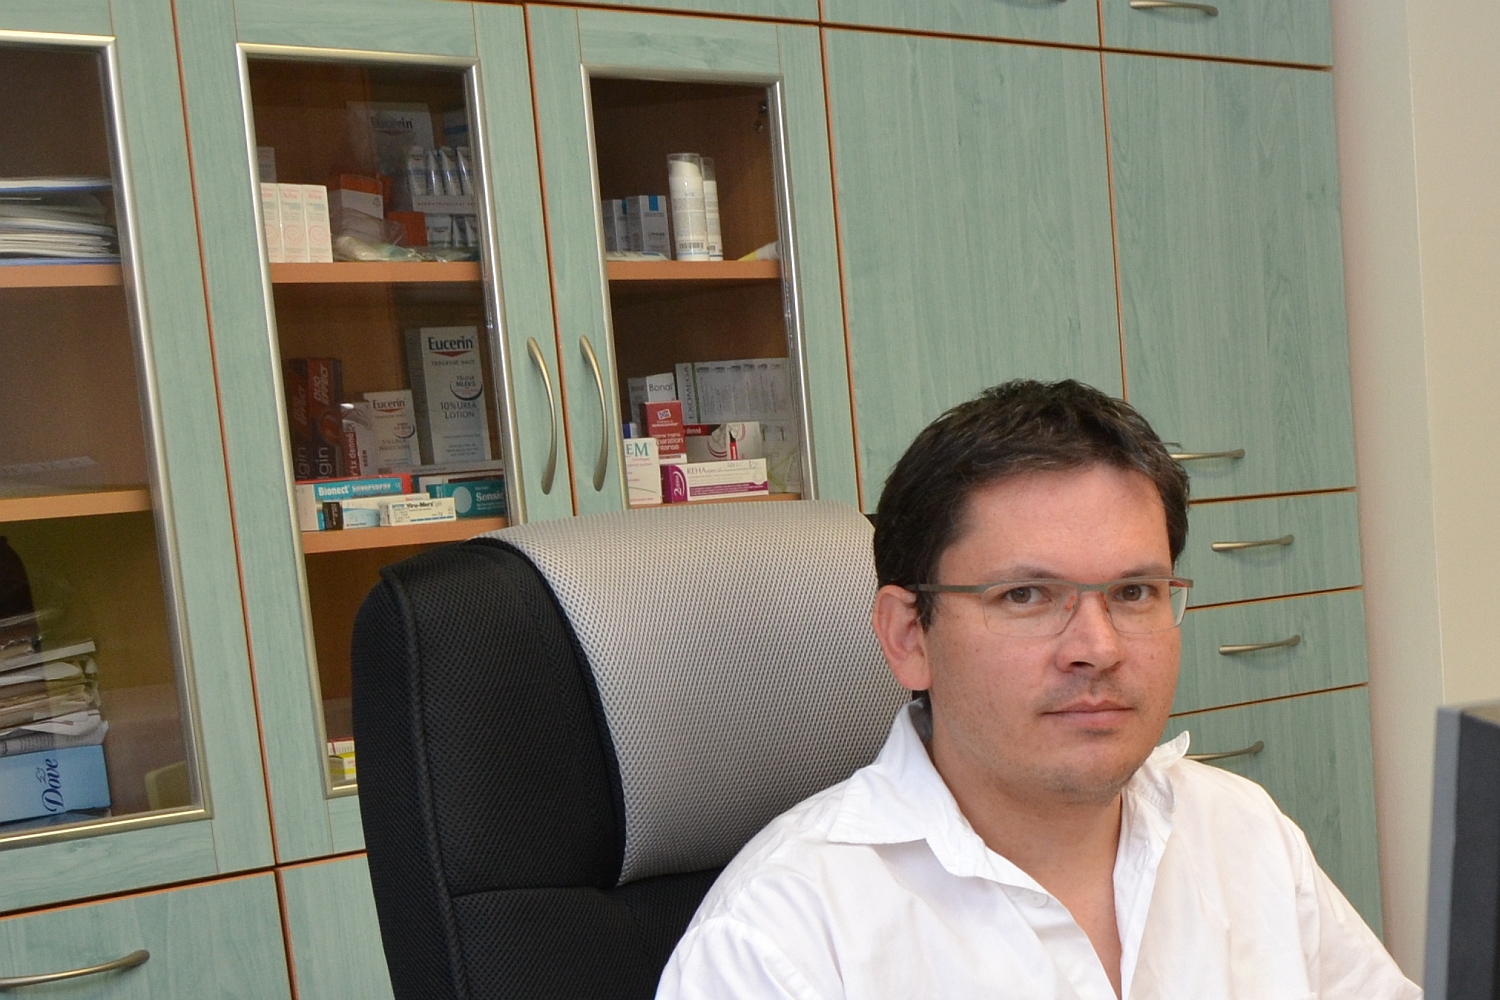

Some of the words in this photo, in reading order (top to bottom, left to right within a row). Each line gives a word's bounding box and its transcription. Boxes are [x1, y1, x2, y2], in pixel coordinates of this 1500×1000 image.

[428, 335, 473, 350] Eucerin
[683, 365, 694, 420] EXOMEGA
[373, 399, 405, 410] Eucerin
[456, 401, 477, 410] UREA
[444, 411, 475, 420] LOTION
[318, 485, 348, 497] Bionect
[41, 758, 65, 813] Dove
